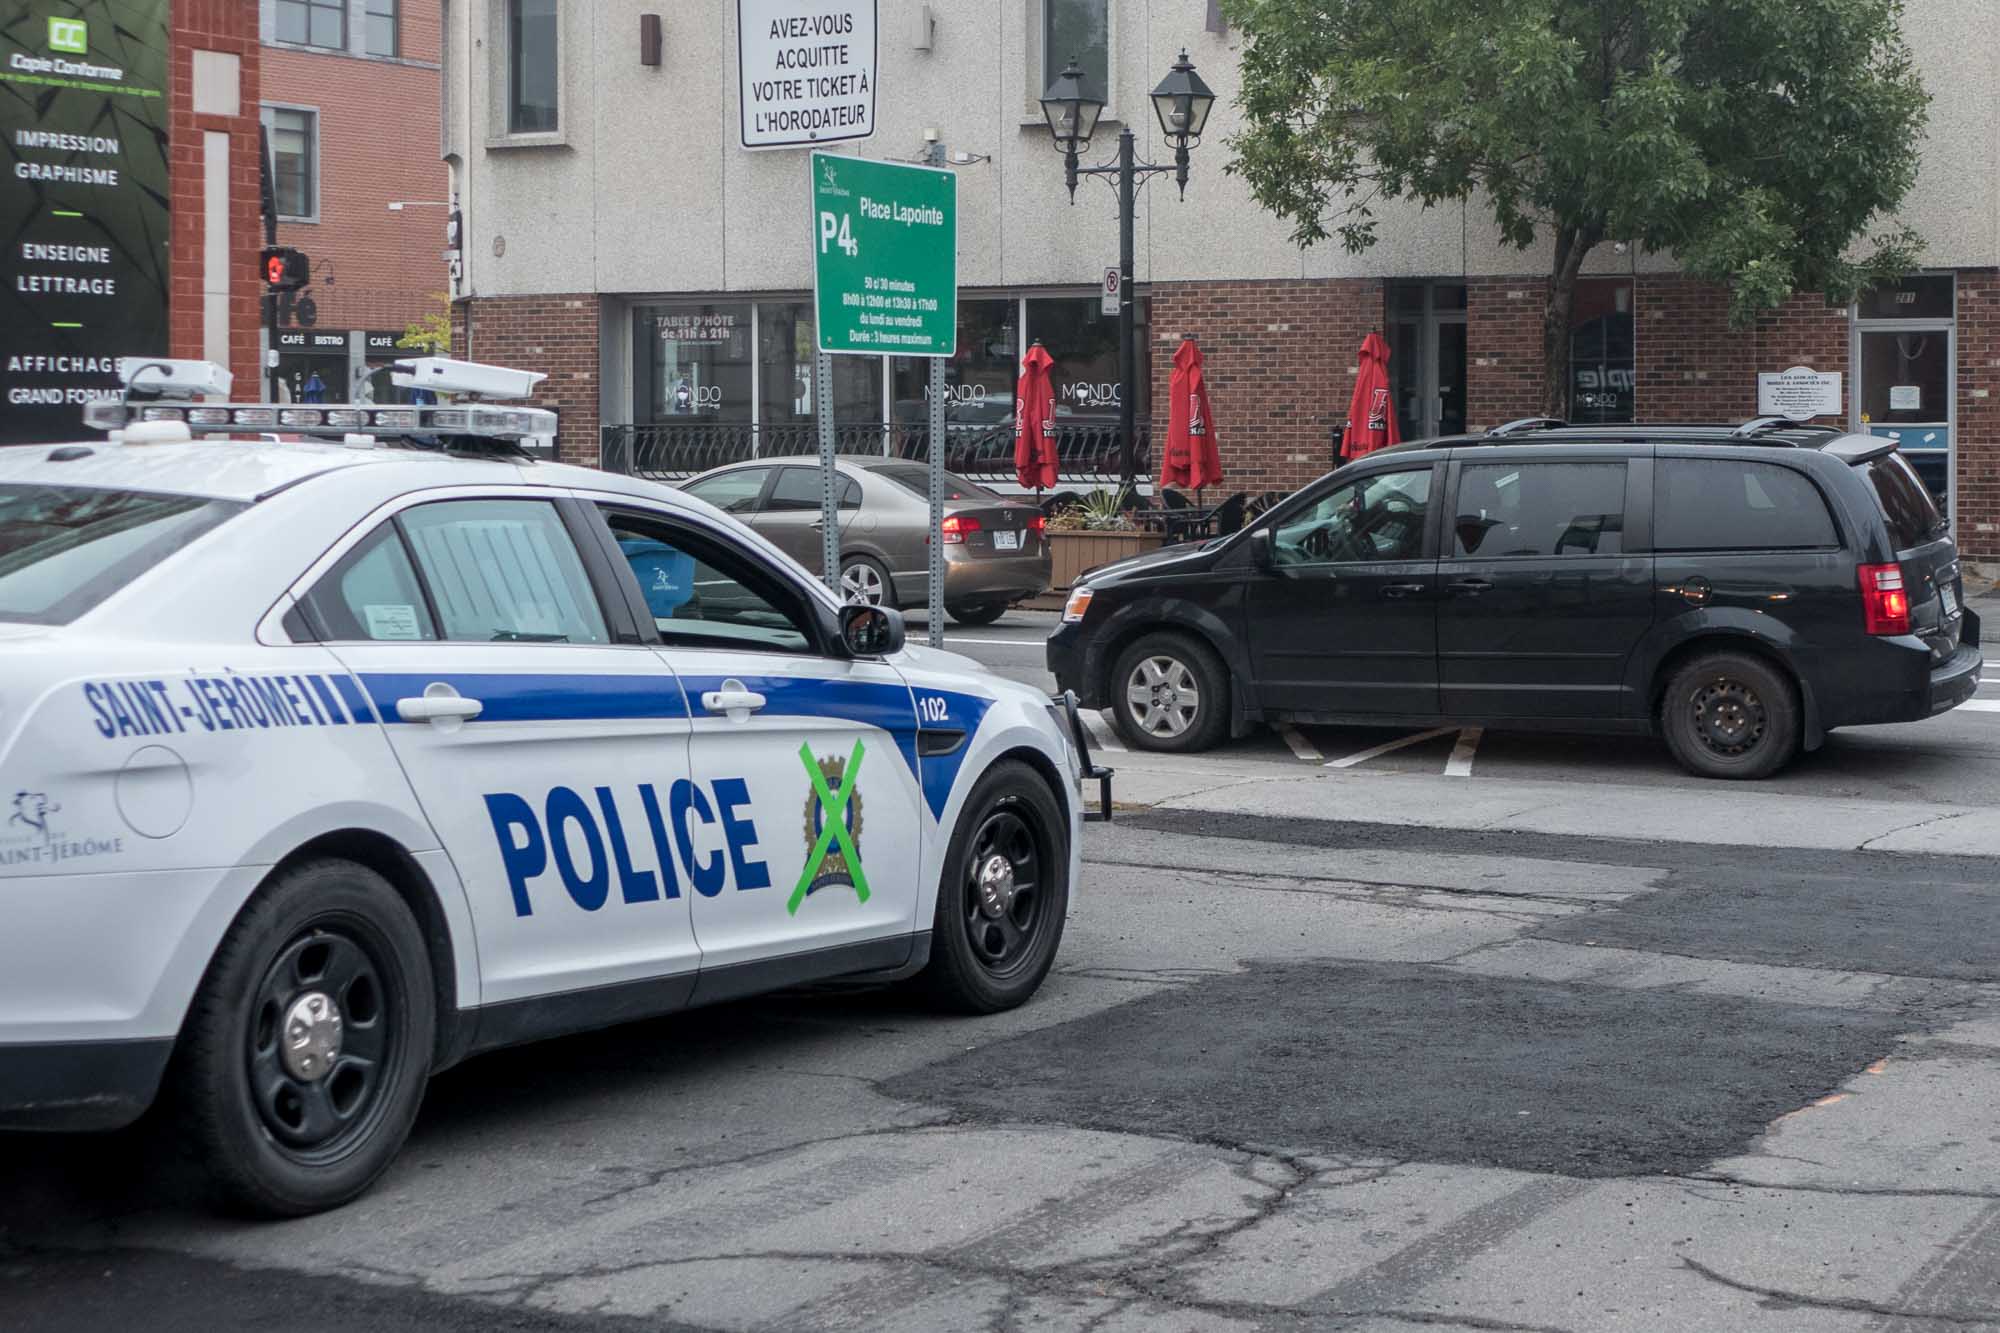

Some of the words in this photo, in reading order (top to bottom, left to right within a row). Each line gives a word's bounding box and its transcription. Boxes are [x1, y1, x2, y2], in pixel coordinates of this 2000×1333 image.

[769, 13, 853, 39] AVEZ-VOUS
[10, 53, 53, 72] Copie
[54, 58, 123, 80] Conforme
[775, 44, 848, 70] ACQUITTE
[752, 79, 803, 102] VOTRE
[807, 74, 857, 98] TICKET
[860, 67, 869, 94] À
[755, 103, 865, 133] L'HORODATEUR
[16, 130, 119, 154] IMPRESSION
[15, 162, 118, 186] GRAPHISME
[860, 196, 891, 220] Place
[893, 201, 944, 227] Lapointe
[22, 243, 110, 263] ENSEIGNE
[17, 275, 115, 295] LETTRAGE
[888, 280, 915, 293] minutes
[656, 316, 690, 327] TABLE
[894, 314, 923, 328] vendredi
[281, 333, 305, 345] CAFÉ
[314, 336, 344, 345] BISTRO
[369, 335, 392, 347] CAFÉ
[661, 327, 675, 339] de
[677, 326, 697, 339] 11h
[699, 327, 707, 339] à
[710, 327, 730, 339] 21h
[901, 331, 932, 345] maximum
[8, 356, 122, 373] AFFICHAGE
[8, 388, 64, 404] GRAND
[65, 388, 125, 404] FORMAT
[920, 697, 949, 721] 102
[482, 778, 771, 917] POLICE
